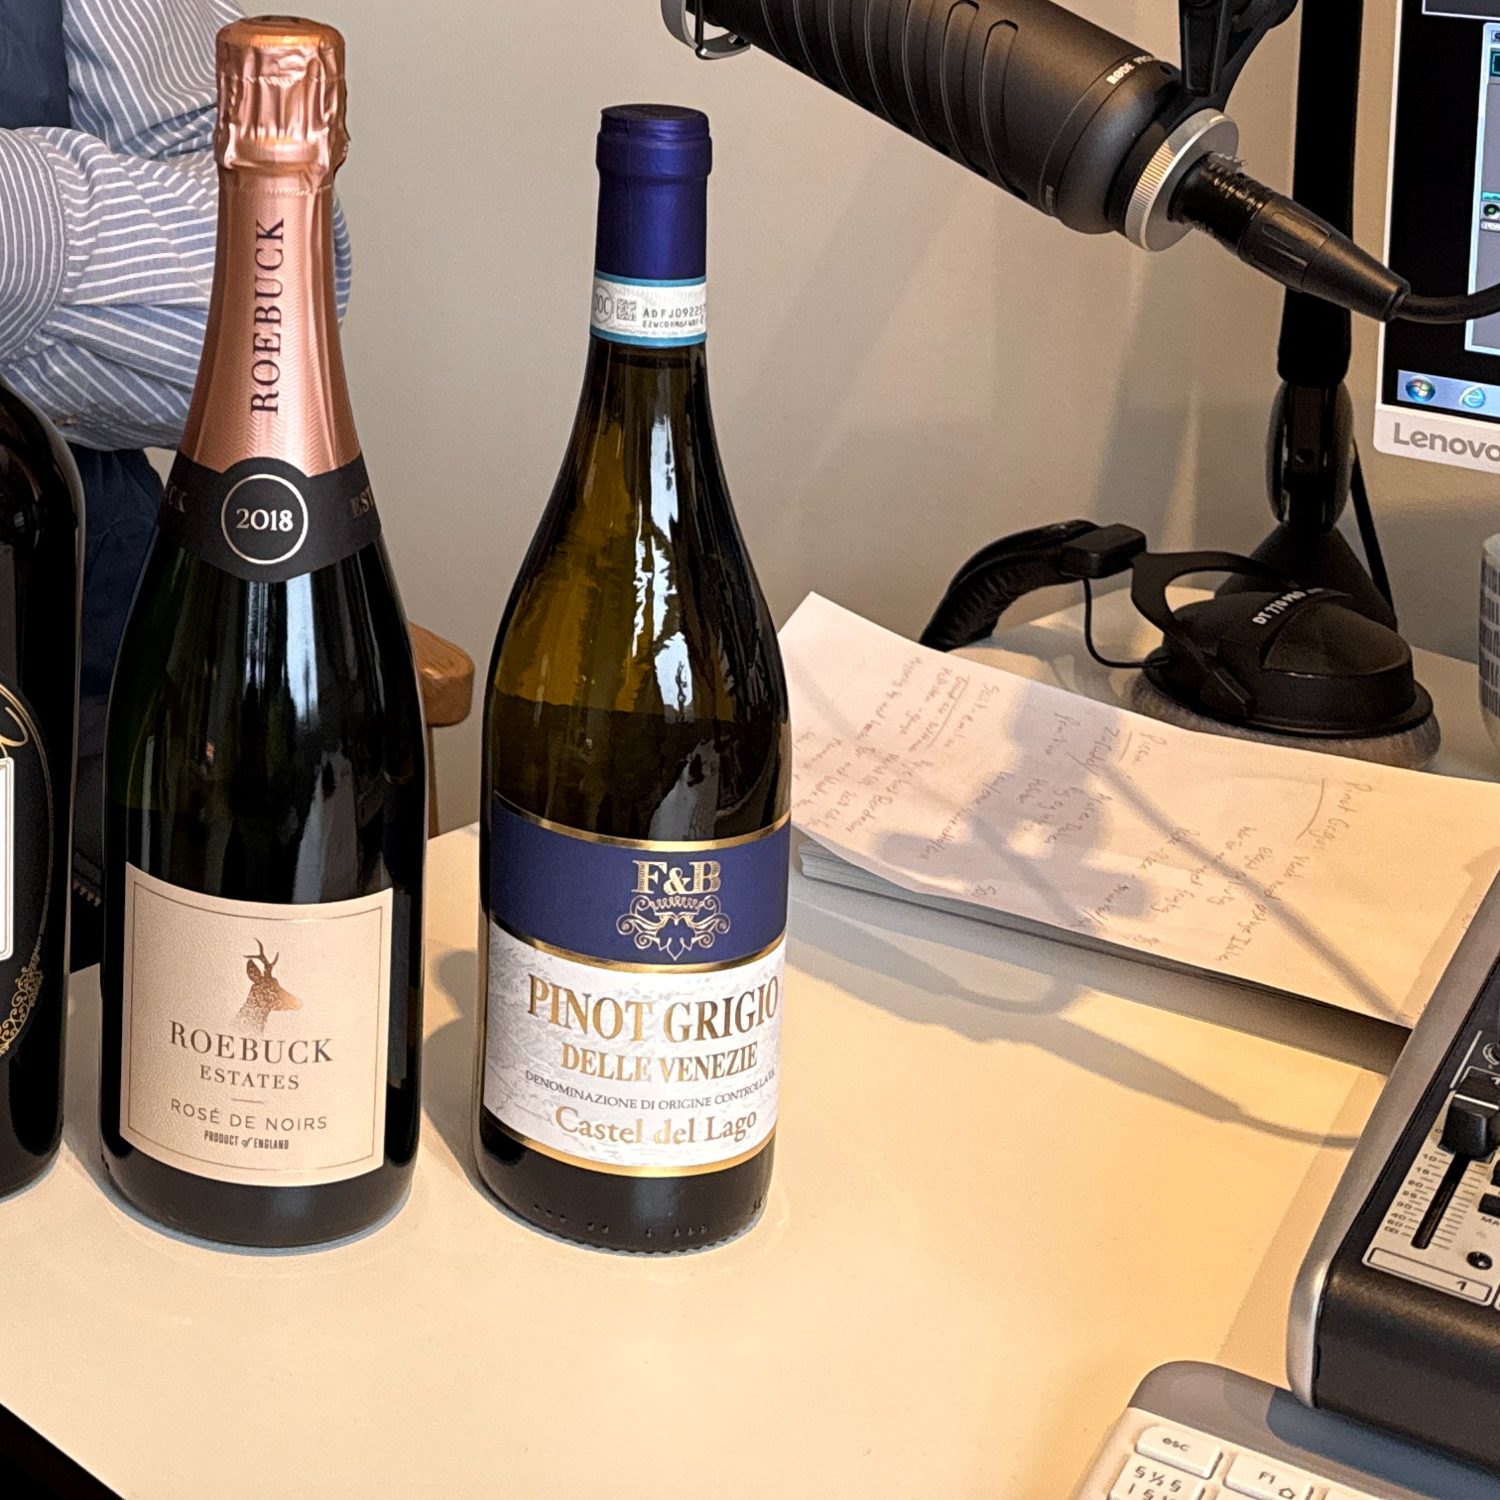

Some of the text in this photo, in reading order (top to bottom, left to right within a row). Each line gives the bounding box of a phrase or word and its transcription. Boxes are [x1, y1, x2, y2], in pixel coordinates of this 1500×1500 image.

[250, 218, 285, 416] ROEBUCK
[1393, 422, 1500, 462] Lenovo
[235, 508, 293, 532] 2018
[631, 859, 722, 896] F&B
[528, 974, 779, 1043] PINOT GRIGIO
[169, 1020, 333, 1065] ROEBUCK
[200, 1064, 300, 1090] ESTATES
[561, 1041, 758, 1083] DELLE VENEZIE
[526, 1070, 637, 1109] DENOMINAZIONE
[641, 1100, 655, 1110] DI
[658, 1097, 711, 1110] ORIGINE
[171, 1098, 327, 1132] ROSÉ DE NOIRS
[555, 1105, 757, 1145] Castel del Lago
[204, 1130, 289, 1150] PRODUCT of ENGLAND
[1162, 1437, 1190, 1452] esc
[1259, 1471, 1276, 1485] F1
